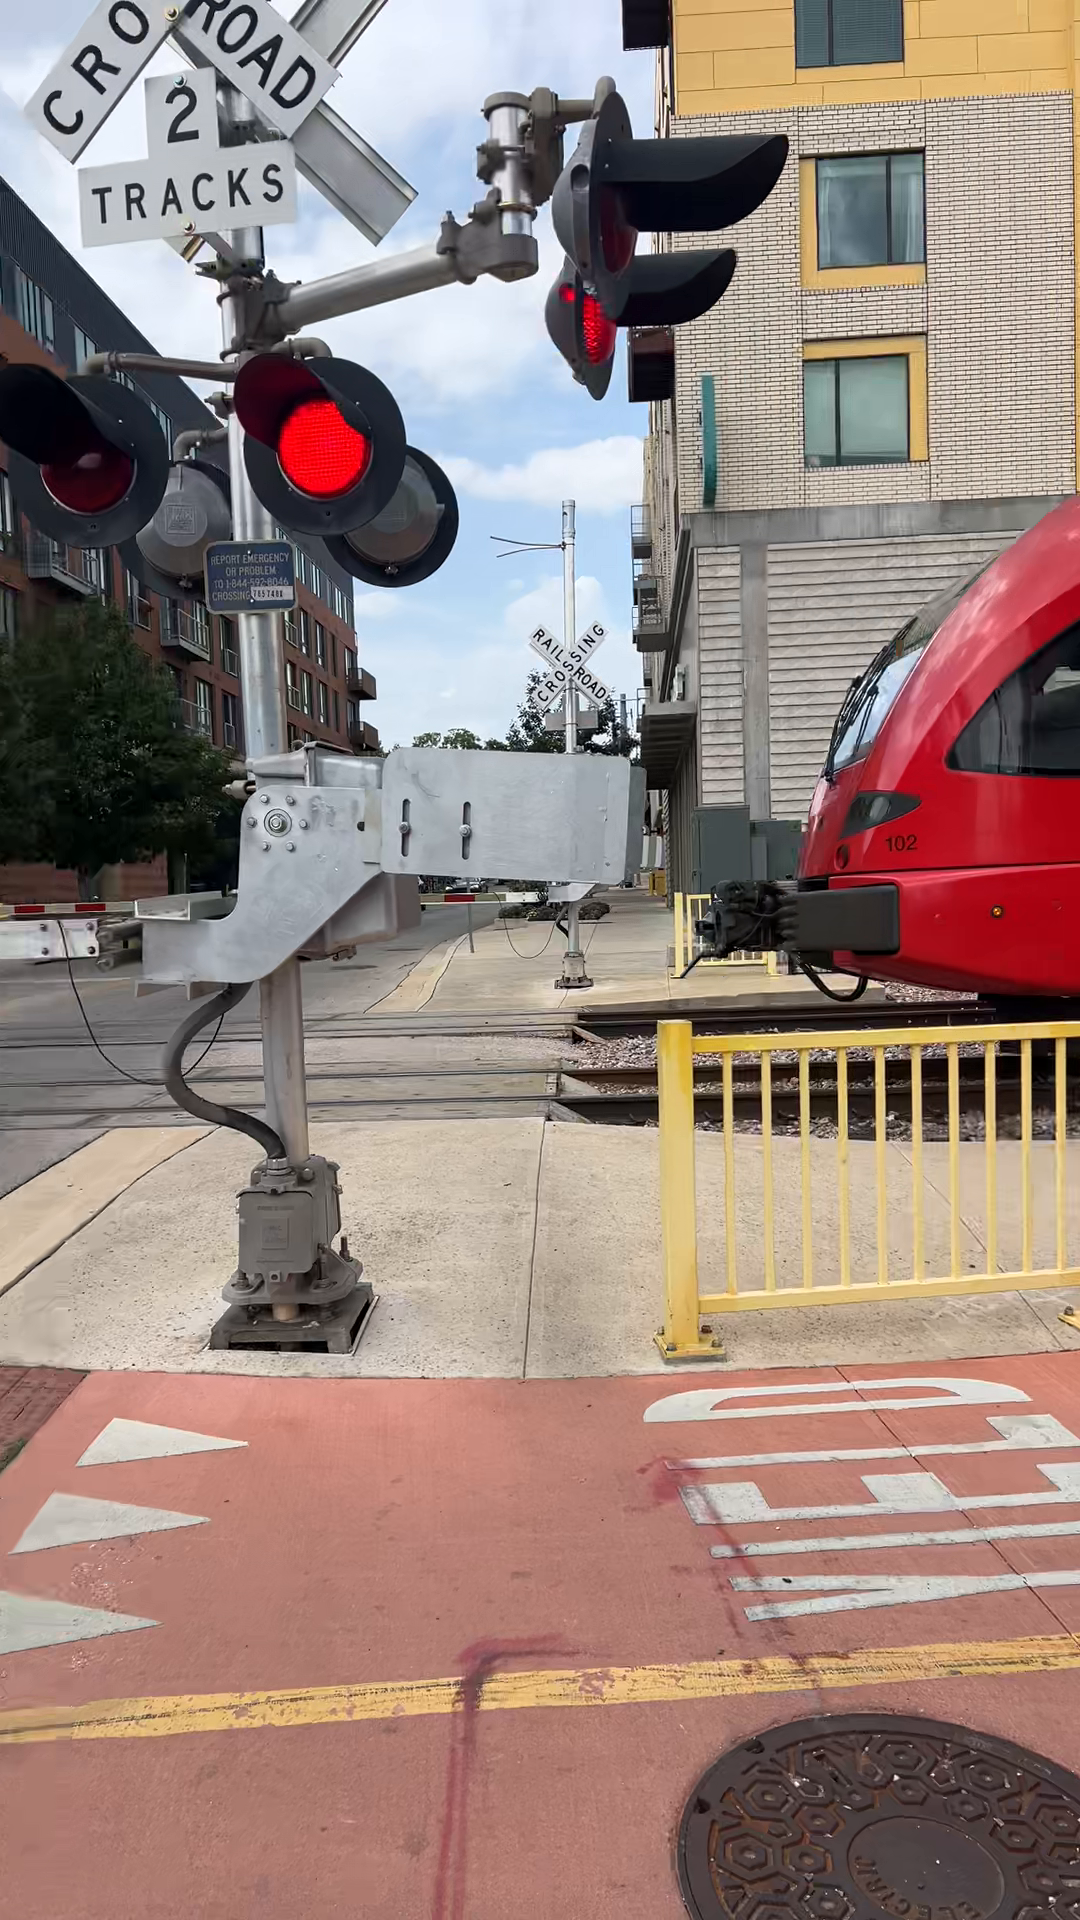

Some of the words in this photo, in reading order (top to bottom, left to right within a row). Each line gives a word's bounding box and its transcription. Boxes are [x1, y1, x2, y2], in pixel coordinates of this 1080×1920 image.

[183, 0, 317, 109] ROAD
[165, 86, 200, 144] 2
[91, 163, 284, 224] TRACKS
[210, 554, 240, 566] REPORT
[242, 552, 290, 564] EMERGENCY
[225, 567, 237, 577] OR
[238, 566, 276, 576] PROBLEM
[212, 590, 250, 601] CROSSING
[213, 579, 224, 589] TO
[532, 628, 564, 662] RAIL
[573, 666, 607, 700] ROAD
[537, 624, 604, 702] CROSSING
[885, 834, 918, 852] 102
